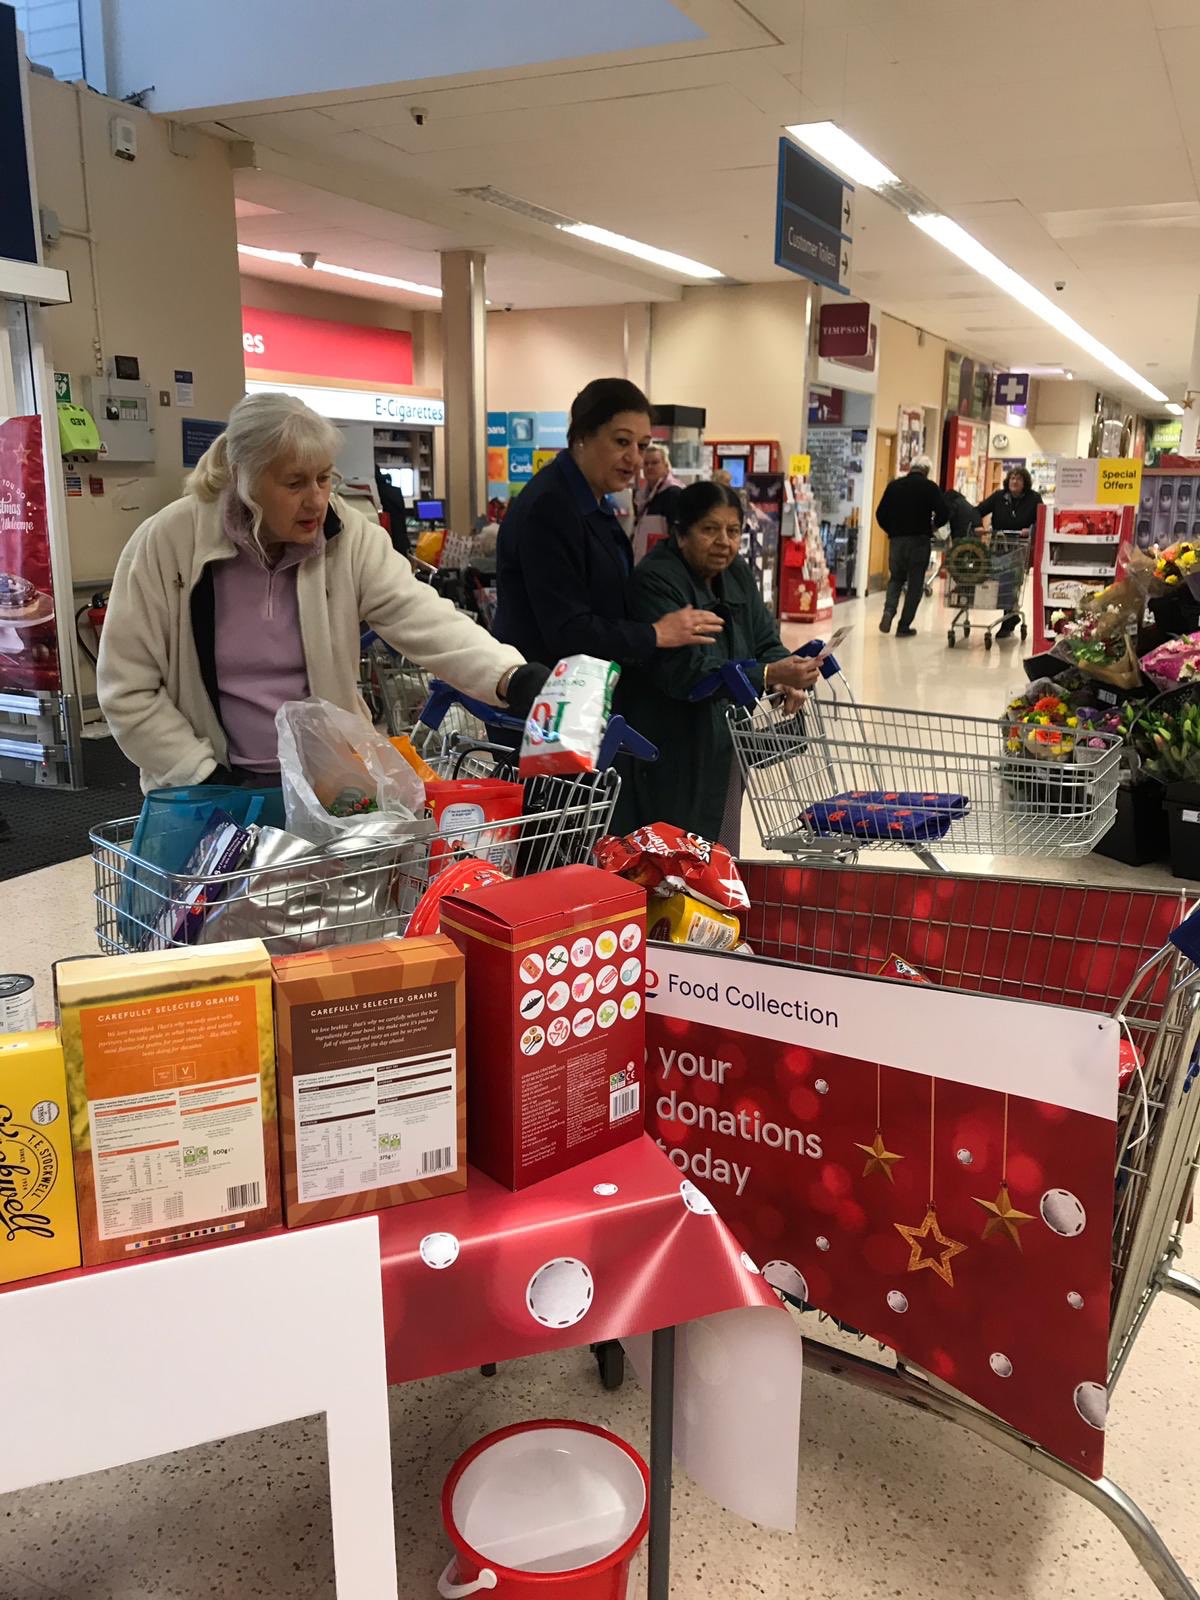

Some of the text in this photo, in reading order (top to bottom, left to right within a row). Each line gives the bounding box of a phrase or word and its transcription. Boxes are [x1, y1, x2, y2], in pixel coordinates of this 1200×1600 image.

[788, 227, 837, 266] Customer Toilets
[822, 325, 866, 335] TIMPSON
[243, 333, 264, 354] es
[70, 417, 86, 426] AED
[375, 398, 444, 422] E-Cigarettes
[1102, 470, 1136, 480] Special
[1104, 481, 1133, 490] Offers
[97, 995, 239, 1021] CAREFULLY SELECTED GRAINS
[310, 991, 437, 1016] CAREFULLY SELECTED GRAINS
[668, 974, 718, 1002] Food
[726, 986, 838, 1028] Collection
[182, 1066, 190, 1076] V
[658, 1047, 732, 1084] your
[37, 1106, 45, 1122] TESCO
[656, 1090, 824, 1159] donations
[32, 1148, 54, 1198] STOCKWELL
